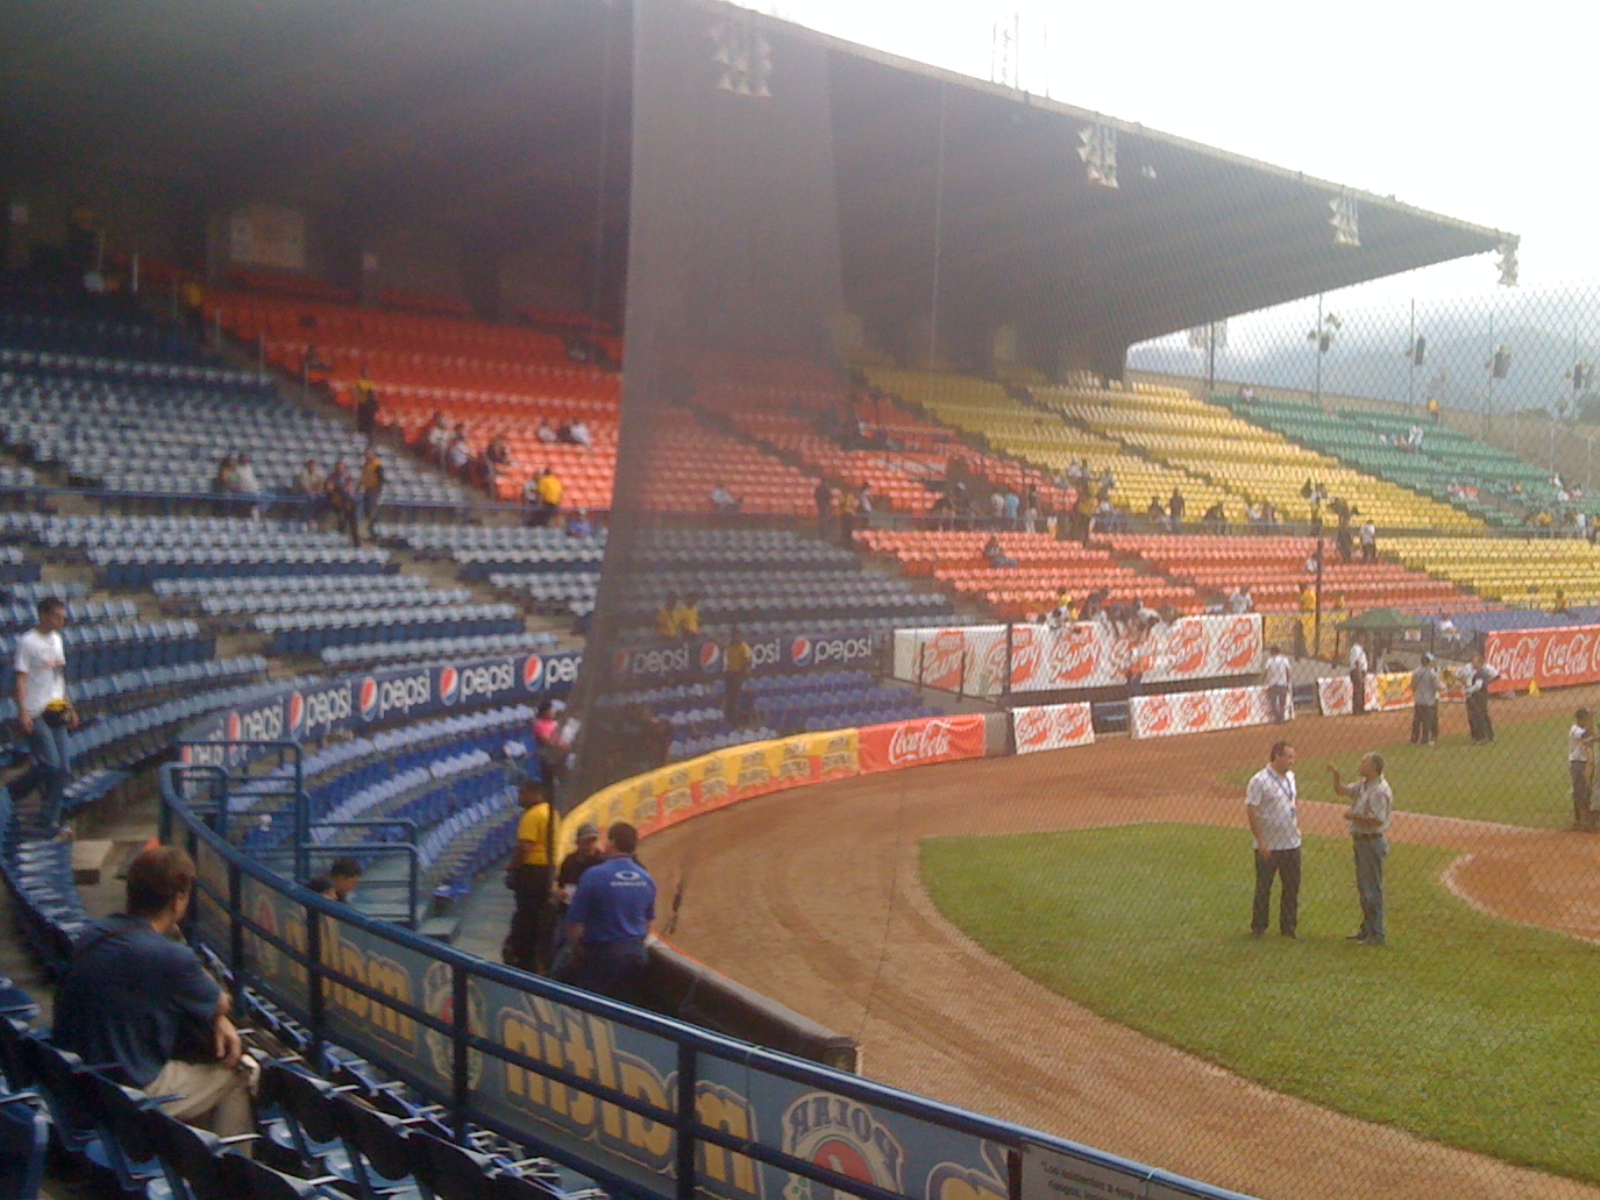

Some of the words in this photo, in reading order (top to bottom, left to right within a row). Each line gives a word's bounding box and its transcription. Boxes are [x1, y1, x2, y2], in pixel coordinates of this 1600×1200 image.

[632, 644, 690, 676] pepsi
[814, 635, 872, 664] pepsi
[378, 669, 431, 715] pepsi
[461, 658, 515, 697] pepsi
[306, 681, 352, 735] pepsi
[889, 721, 952, 765] Coca-Cola
